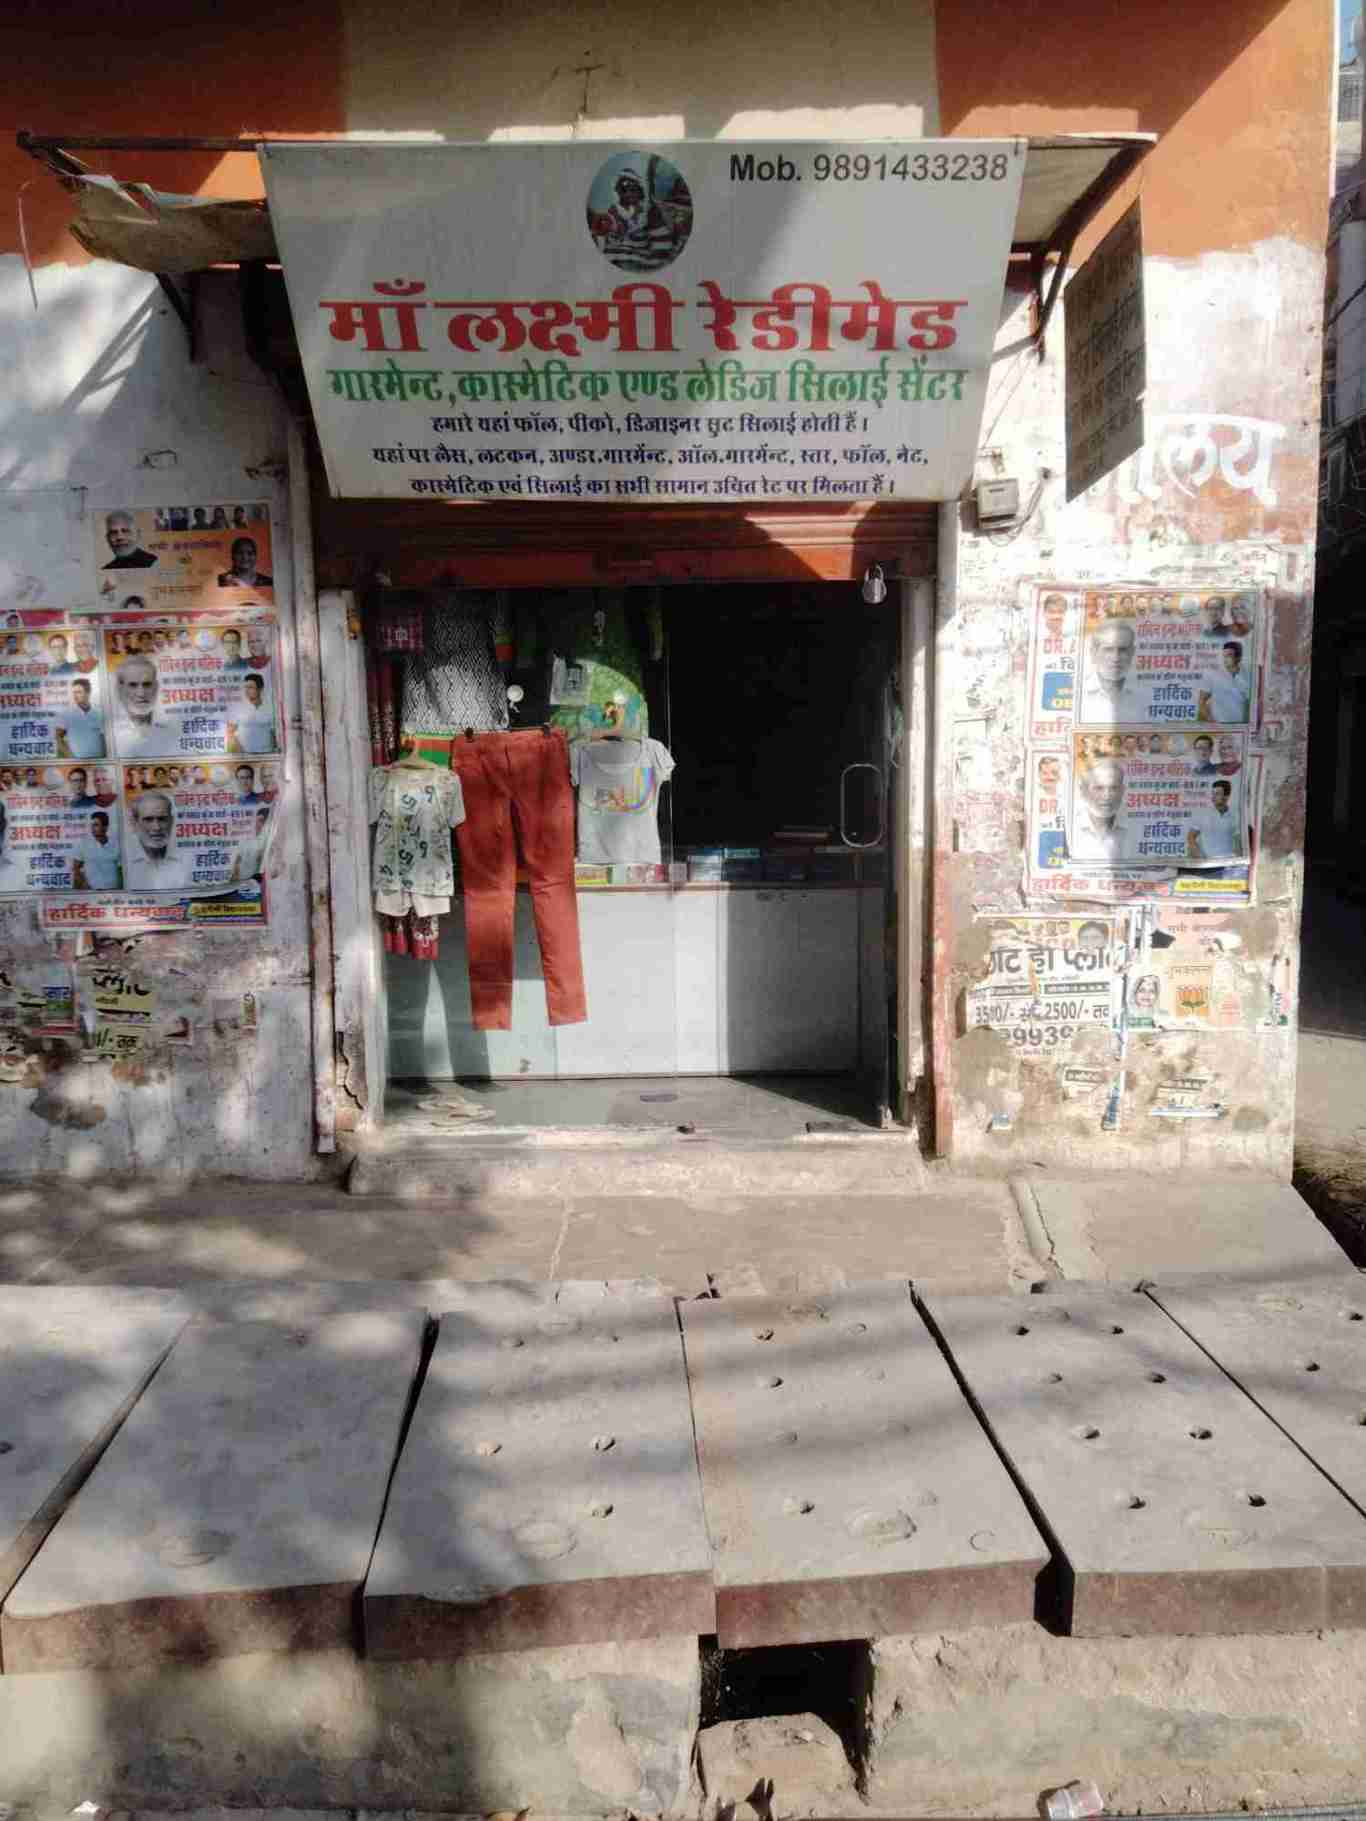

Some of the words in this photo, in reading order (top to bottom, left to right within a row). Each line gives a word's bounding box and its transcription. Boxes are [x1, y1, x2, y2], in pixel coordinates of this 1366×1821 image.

[729, 154, 802, 181] Mob.
[813, 154, 1009, 181] 9891433238
[319, 277, 427, 352] माँ
[433, 282, 685, 357] लक्ष्मी
[697, 280, 969, 352] रेडीमेड
[614, 369, 681, 401] एण्ड
[682, 357, 781, 401] लेडिज
[784, 355, 890, 408] सिलाई
[896, 354, 969, 401] सेंटर
[430, 412, 475, 433] हमारे
[477, 410, 511, 433] यहां
[625, 412, 701, 437] डिजाइनर
[739, 412, 801, 436] सिलाई
[800, 412, 841, 433] होती
[371, 442, 406, 464] यहां
[407, 448, 431, 464] पर
[497, 473, 522, 494] एवं
[525, 474, 584, 497] सिलाई
[585, 479, 611, 494] का
[614, 475, 651, 494] सभी
[655, 479, 710, 494] सामान
[713, 475, 757, 494] उचित
[760, 474, 783, 494] रेट
[785, 480, 808, 494] पर
[811, 475, 869, 494] मिलता
